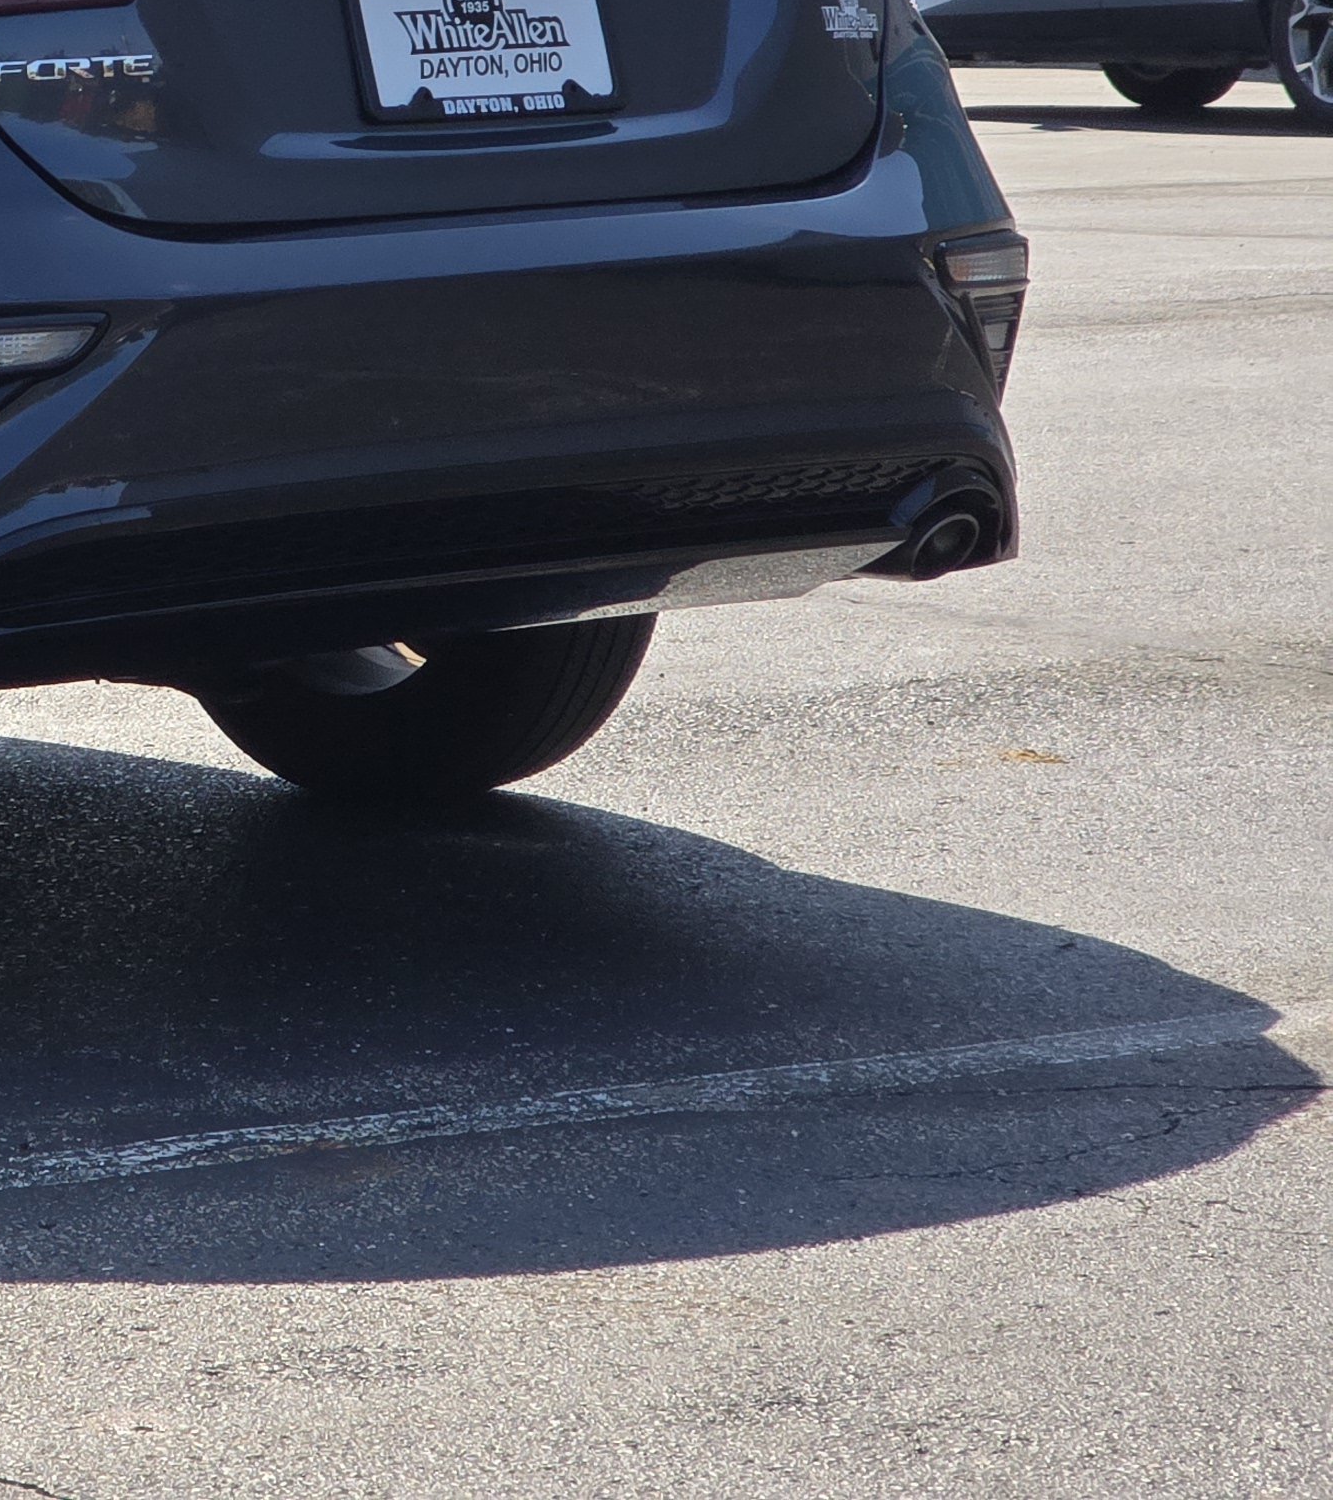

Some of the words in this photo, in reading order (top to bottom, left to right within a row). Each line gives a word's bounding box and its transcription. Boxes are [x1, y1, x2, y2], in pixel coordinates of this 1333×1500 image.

[460, 0, 490, 14] 1935
[420, 55, 509, 80] DAYTON,
[514, 51, 563, 73] OHIO
[443, 97, 518, 115] DAYTON,
[525, 94, 565, 110] OHIO
